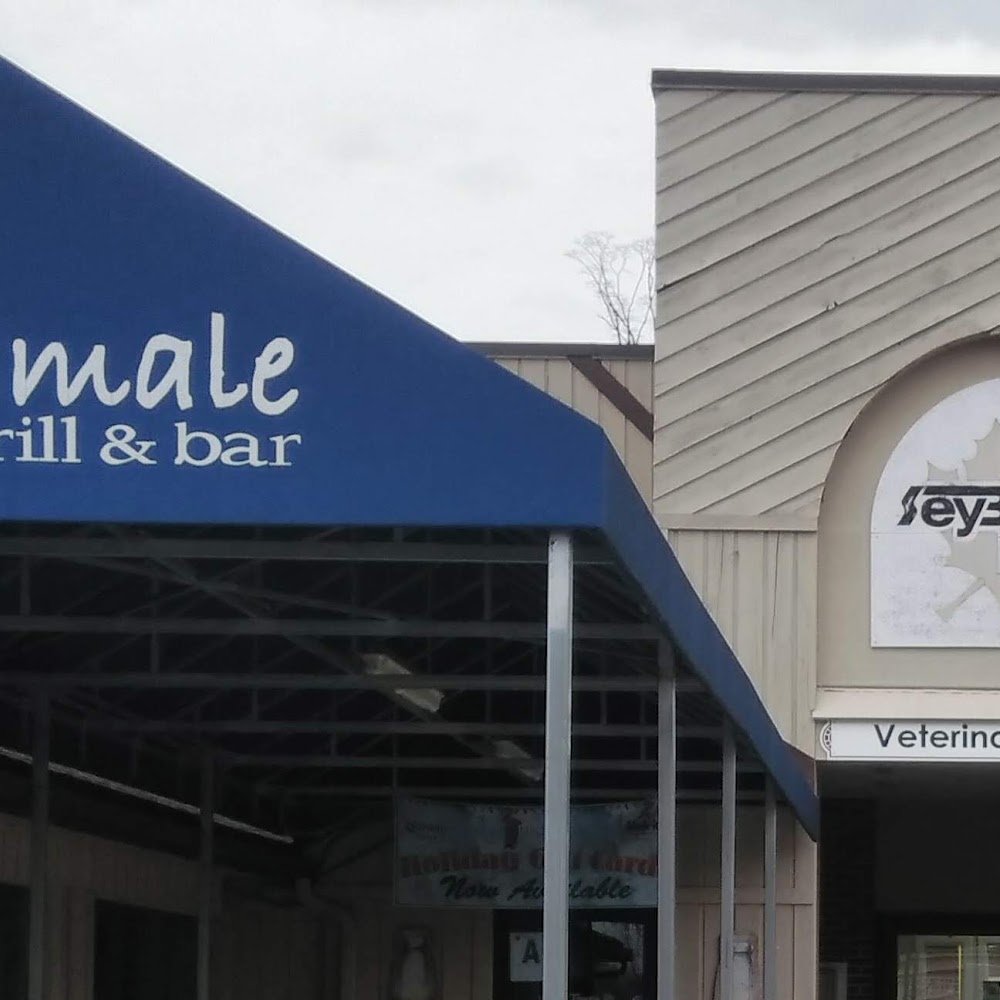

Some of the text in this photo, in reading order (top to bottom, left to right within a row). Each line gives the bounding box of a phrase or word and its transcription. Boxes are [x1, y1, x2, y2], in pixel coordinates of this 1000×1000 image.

[12, 312, 299, 416] male
[99, 423, 158, 465] &
[173, 421, 302, 467] bar
[440, 875, 498, 899] Now
